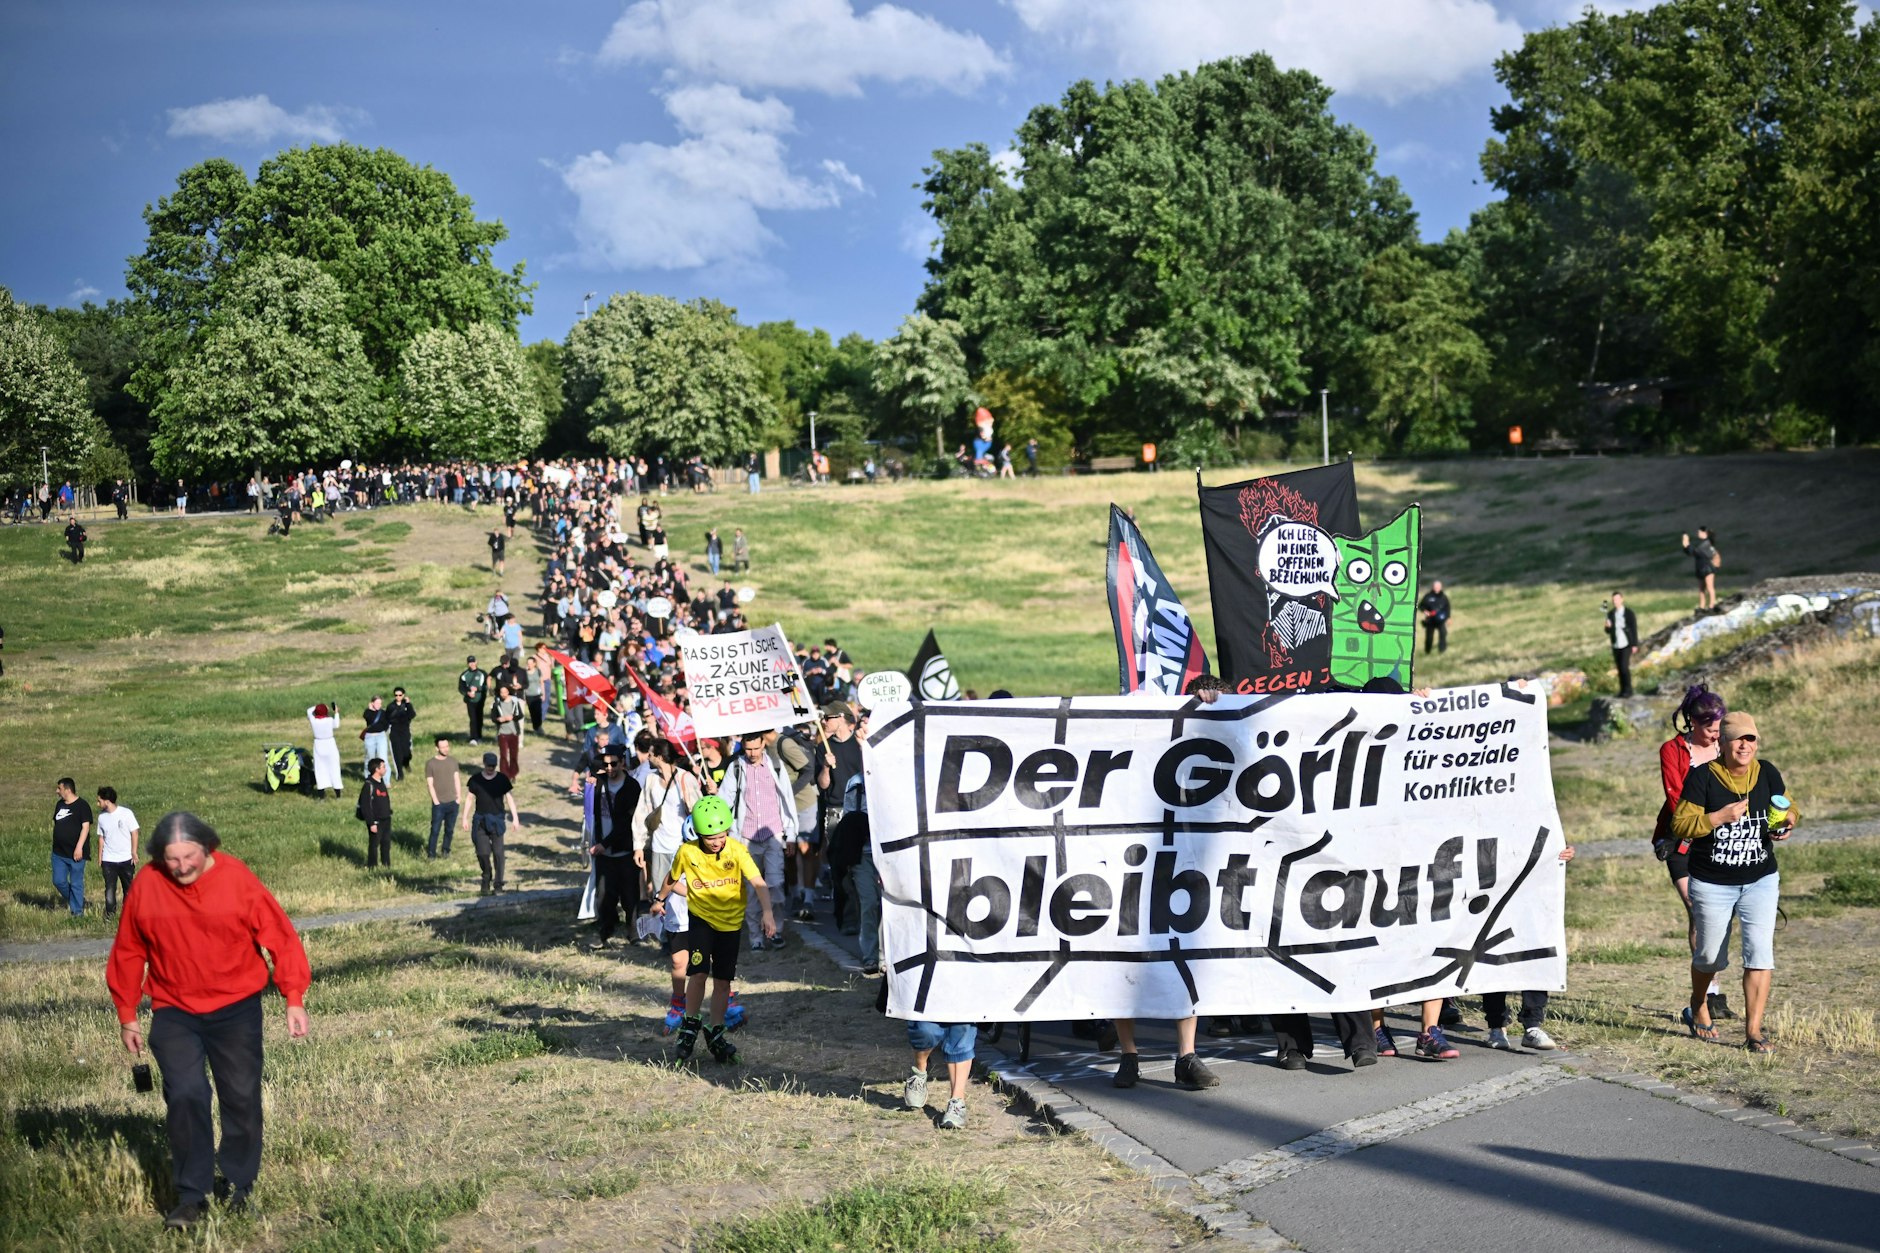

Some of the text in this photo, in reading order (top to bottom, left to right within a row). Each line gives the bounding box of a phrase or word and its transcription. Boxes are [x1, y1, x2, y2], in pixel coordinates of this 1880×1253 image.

[1278, 528, 1318, 542] ICH LEBE
[1277, 543, 1319, 556] IN EINER
[1277, 556, 1324, 570] OFFENEN
[1269, 568, 1330, 585] BEZIEHUNG
[683, 637, 779, 660] RASSISTISCHE
[710, 659, 769, 679] ZÄUNE
[694, 673, 791, 698] ZERSTÖREN
[872, 685, 903, 697] BLEIBT
[1237, 670, 1313, 695] GEGEN
[717, 694, 779, 716] LEBEN
[1410, 689, 1490, 715] soziale
[1407, 718, 1516, 744] Lösungen
[935, 723, 1399, 814] Der Görli
[1403, 744, 1520, 771] für soziale
[1404, 772, 1516, 802] Konflikte!
[1716, 825, 1761, 840] Görli
[945, 836, 1498, 941] bleibt auf!
